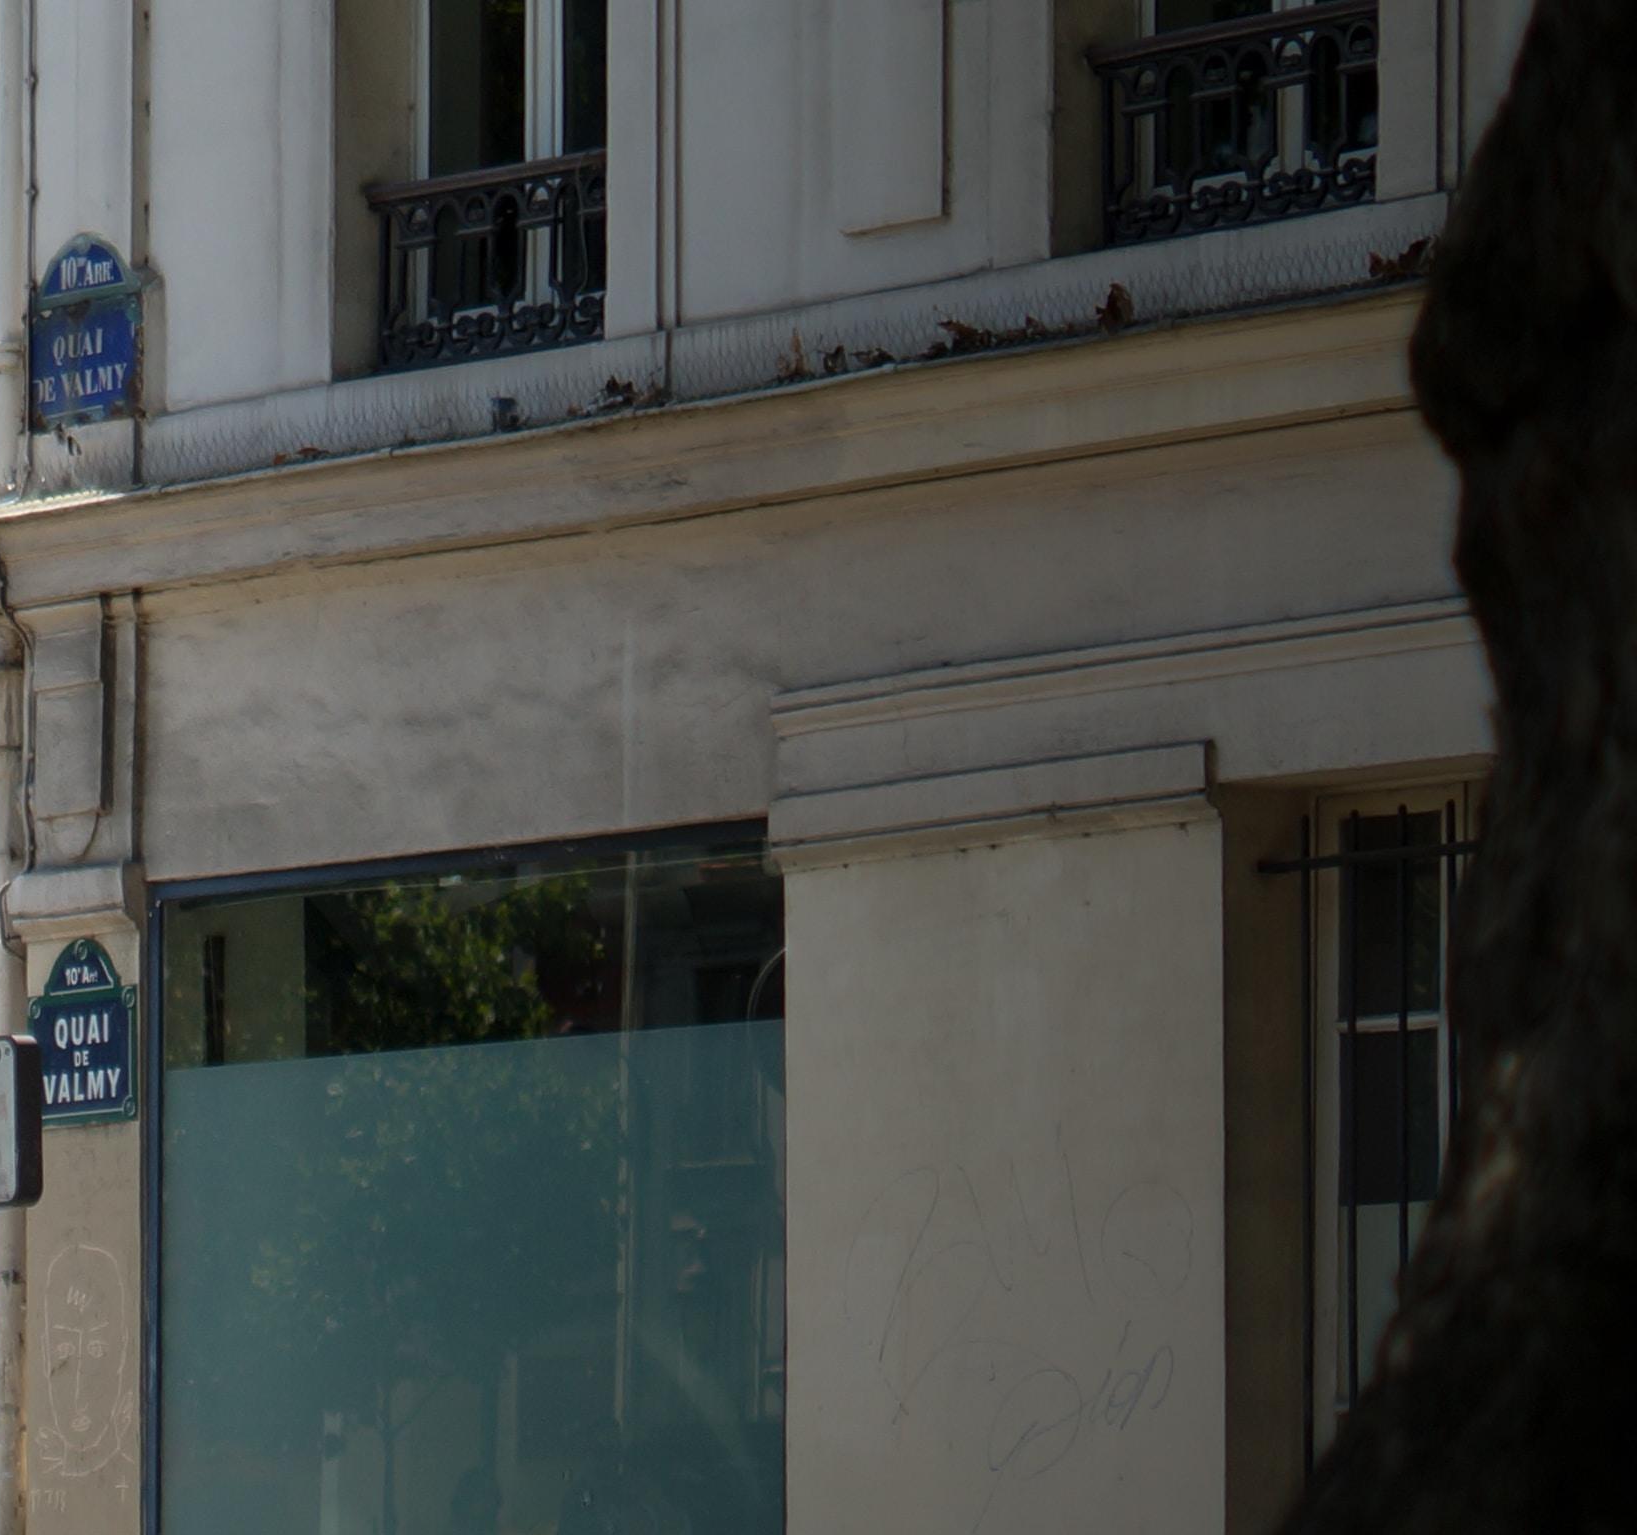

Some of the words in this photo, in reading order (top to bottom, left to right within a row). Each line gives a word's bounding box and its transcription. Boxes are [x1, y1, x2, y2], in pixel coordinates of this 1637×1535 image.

[53, 328, 104, 366] QUAI
[33, 376, 57, 404] DE
[61, 362, 127, 398] VALMY
[54, 1013, 109, 1050] QUAI
[73, 1050, 90, 1068] DE
[42, 1068, 121, 1105] VALMY
